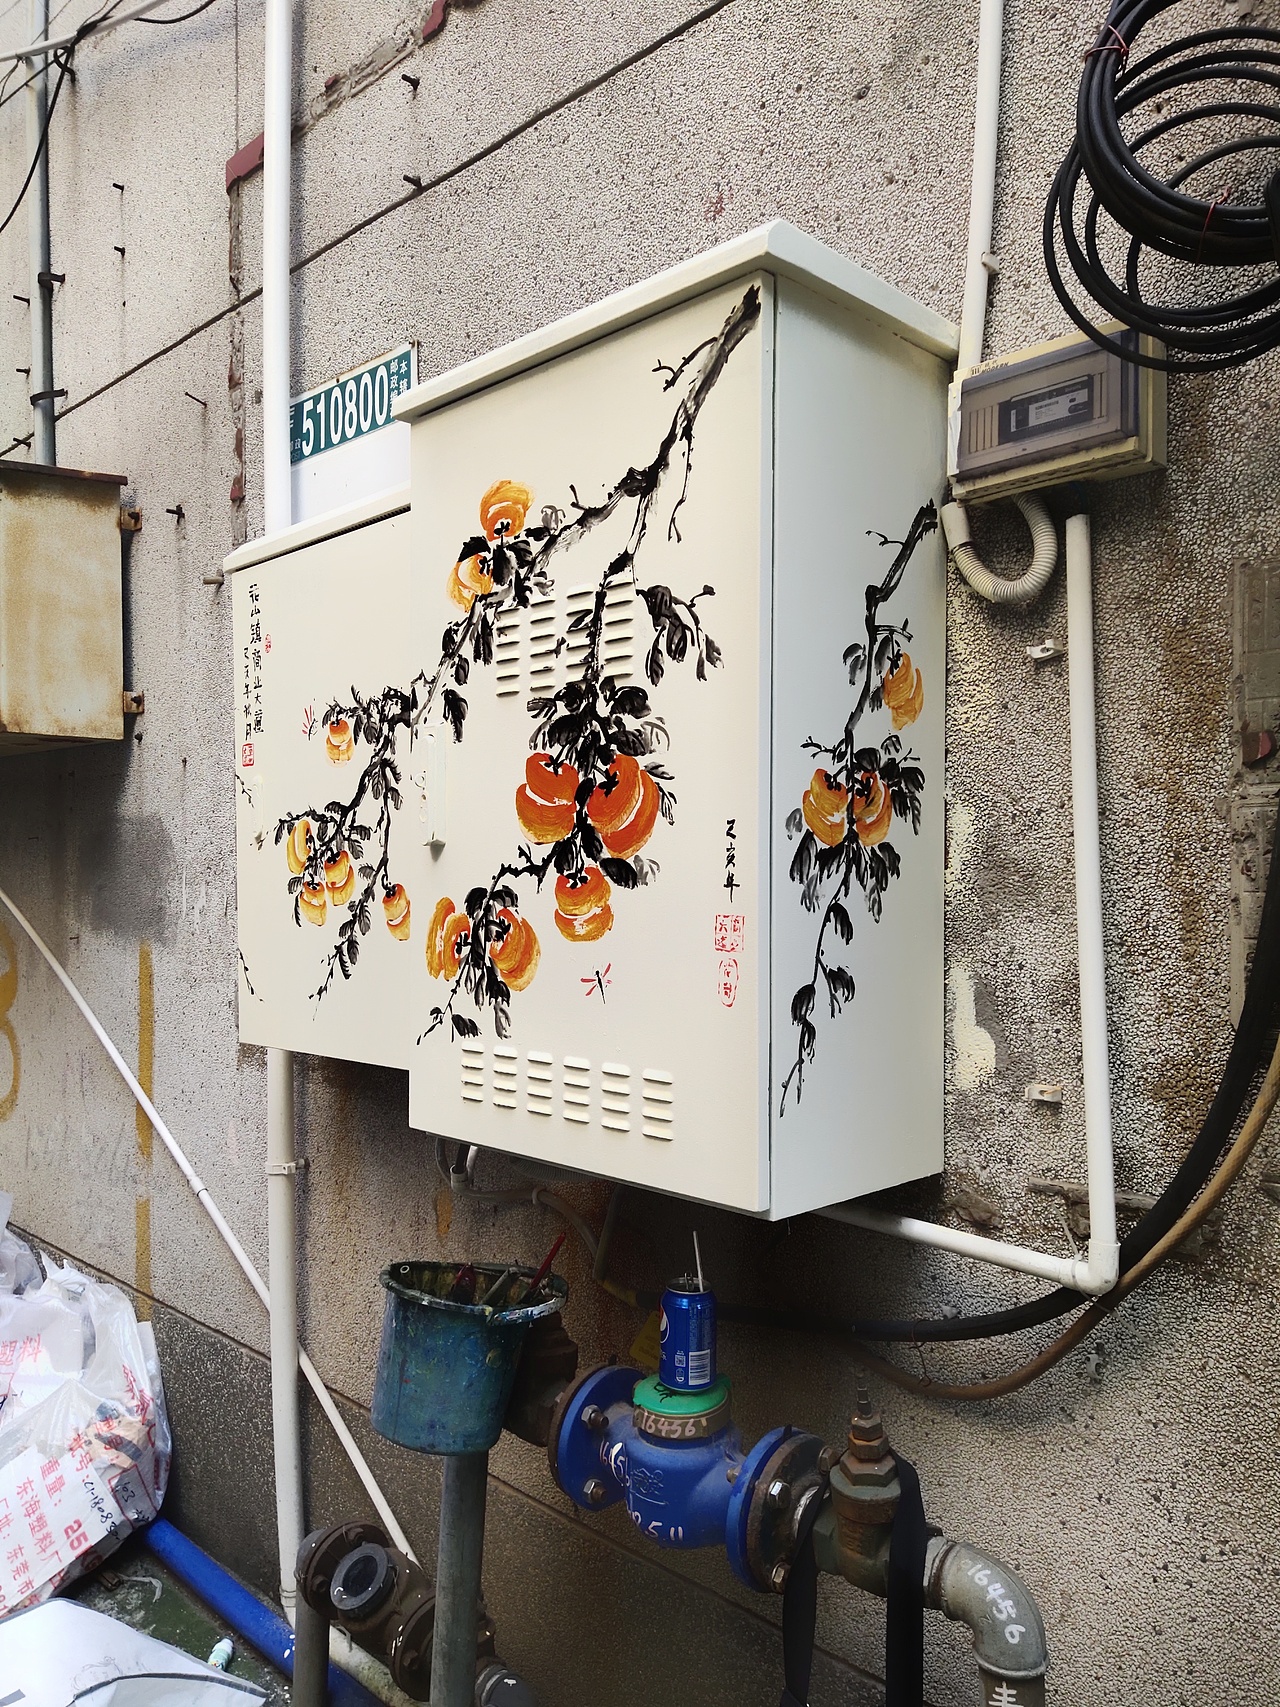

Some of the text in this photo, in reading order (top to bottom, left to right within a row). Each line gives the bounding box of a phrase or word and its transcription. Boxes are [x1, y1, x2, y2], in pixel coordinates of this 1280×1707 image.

[301, 364, 389, 456] 510800
[641, 1409, 696, 1439] 16456
[968, 1564, 1026, 1645] 16456
